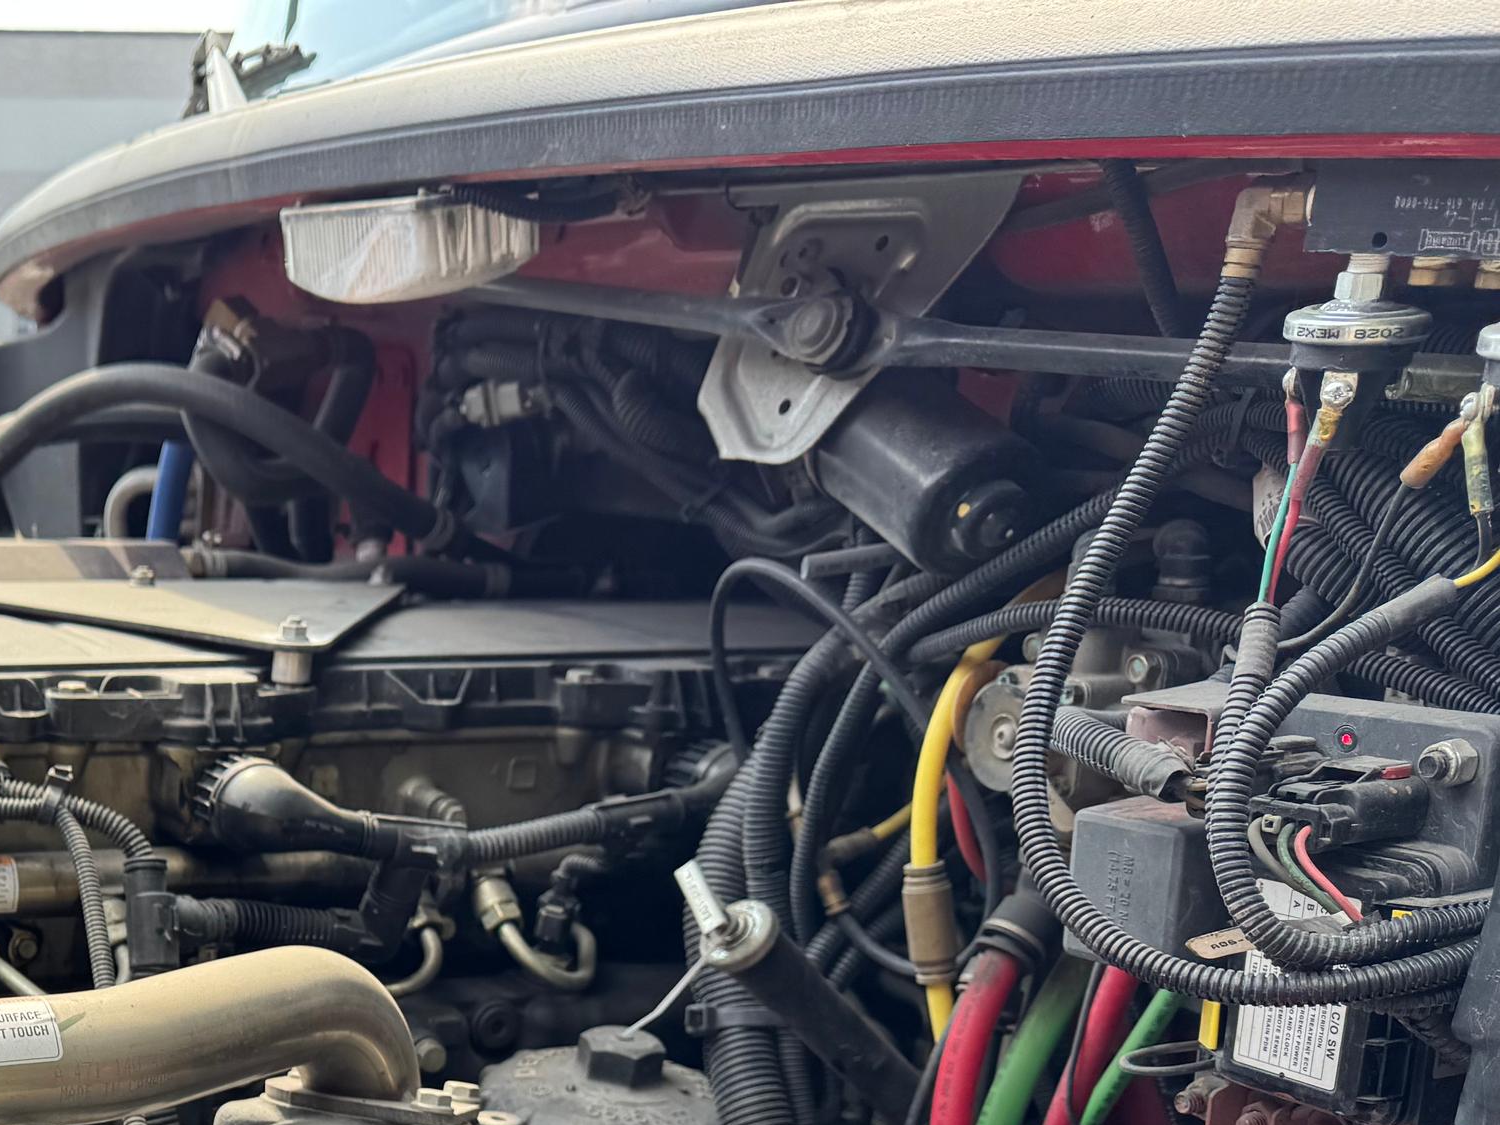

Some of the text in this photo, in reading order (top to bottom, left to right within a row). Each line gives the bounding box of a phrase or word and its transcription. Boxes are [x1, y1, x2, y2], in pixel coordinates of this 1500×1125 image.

[1293, 899, 1301, 909] A
[1306, 902, 1315, 912] B
[11, 1024, 51, 1039] TOUCH
[1326, 1011, 1341, 1061] C/O SW
